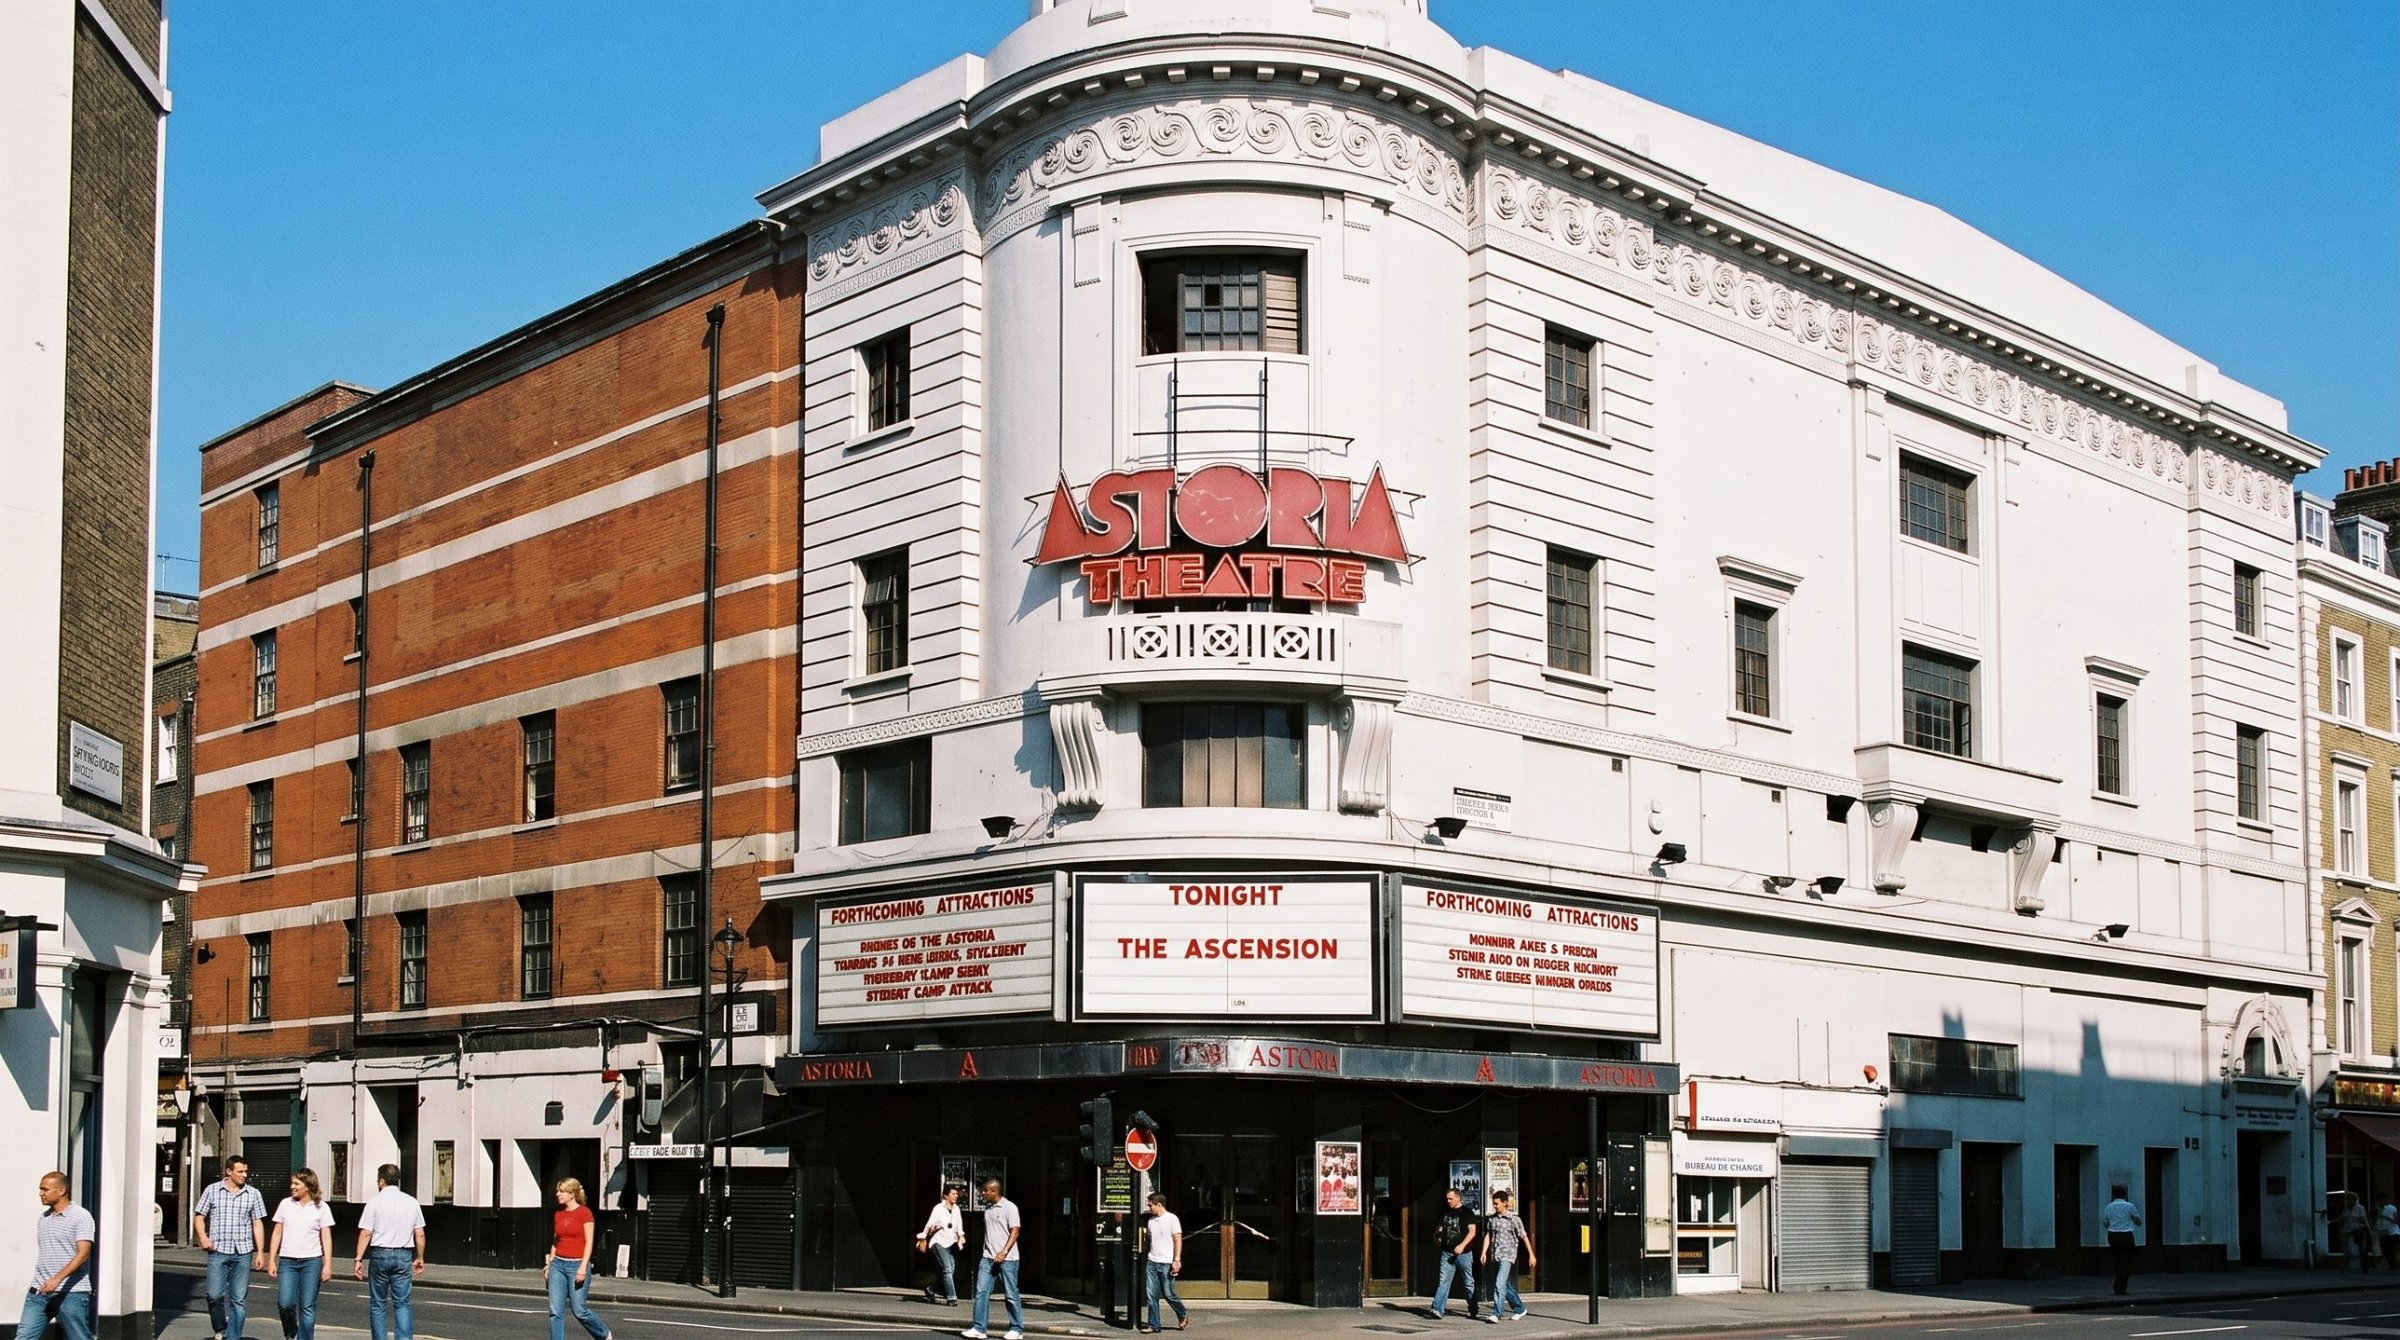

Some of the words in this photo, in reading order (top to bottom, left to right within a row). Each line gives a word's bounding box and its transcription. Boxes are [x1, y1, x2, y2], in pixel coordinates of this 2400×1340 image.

[1035, 461, 1411, 565] ASTORIA
[1080, 553, 1368, 604] THEATRE
[831, 900, 925, 925] FORTHCOMING
[936, 887, 1034, 914] ATTRACTIONS
[1169, 885, 1283, 906] TONIGHT
[1427, 890, 1533, 919] FORTHCOMING
[1547, 907, 1639, 932] ATTRACTIONS
[920, 934, 942, 948] THE
[945, 929, 996, 945] ASTORIA
[1117, 938, 1168, 959] THE
[1184, 938, 1338, 960] ASCENSION
[1516, 956, 1530, 968] ON
[914, 985, 946, 999] CAMP
[949, 981, 993, 996] ATTACK
[801, 1060, 873, 1081] ASTORIA
[960, 1051, 979, 1078] A
[1249, 1045, 1338, 1072] ASTORIA
[1475, 1055, 1495, 1083] A
[1579, 1065, 1657, 1089] ASTORIA
[1684, 1161, 1717, 1171] BUREAU
[1718, 1163, 1729, 1171] DE
[1730, 1163, 1764, 1172] CHANGE
